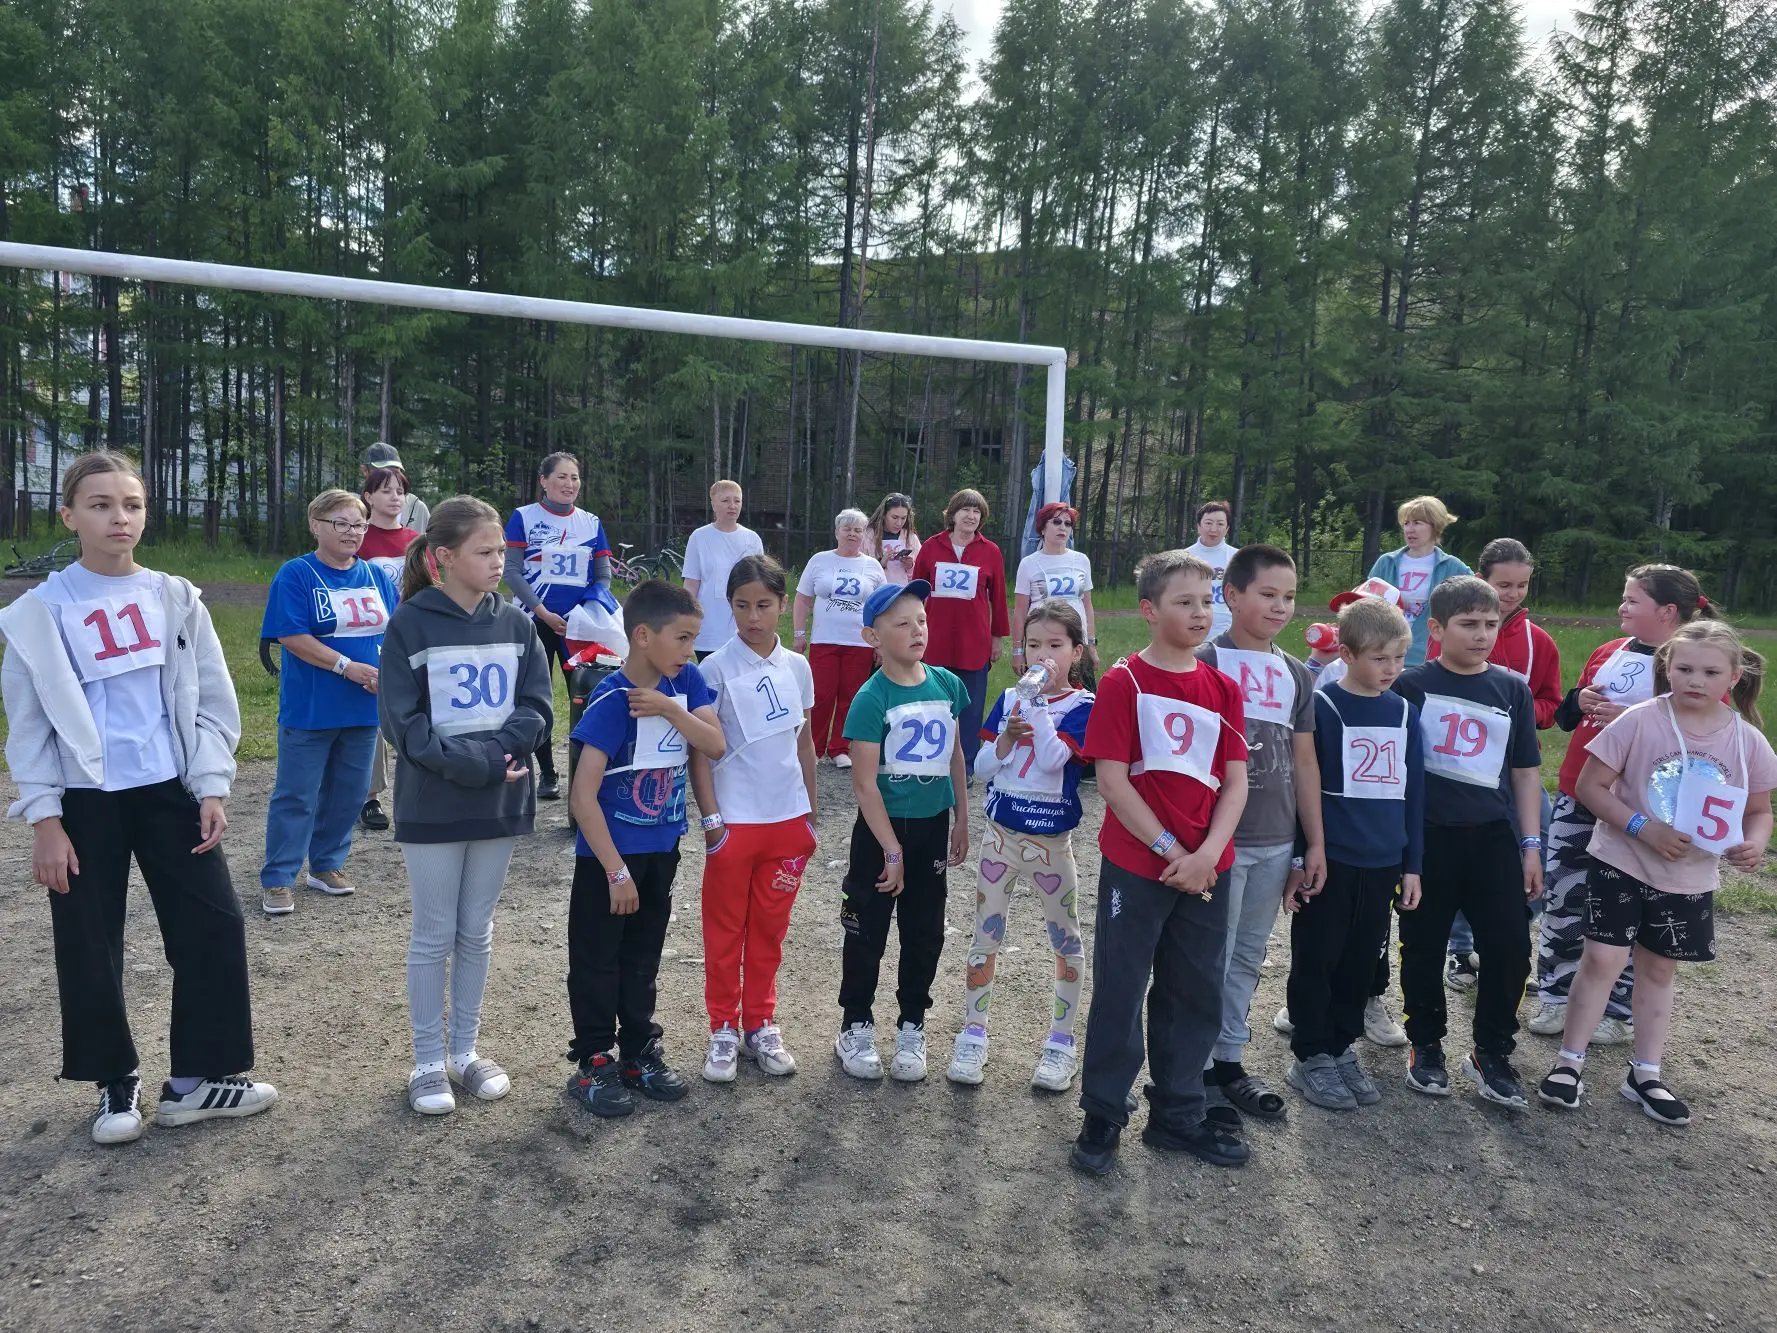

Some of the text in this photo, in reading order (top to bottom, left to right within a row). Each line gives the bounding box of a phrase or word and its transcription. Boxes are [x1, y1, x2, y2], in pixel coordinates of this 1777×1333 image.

[550, 553, 578, 577] 31
[942, 569, 970, 590] 32
[1399, 571, 1429, 592] 17
[834, 577, 861, 596] 23
[1049, 576, 1076, 596] 22
[343, 597, 384, 627] 15
[84, 602, 161, 660] 11
[449, 663, 508, 709] 30
[1610, 661, 1646, 694] 3
[756, 676, 789, 721] 1
[895, 719, 947, 762] 29
[1164, 712, 1194, 756] 9
[1433, 712, 1488, 757] 19
[1017, 738, 1036, 778] 7
[1351, 738, 1400, 784] 21
[1652, 754, 1670, 766] GIRLS
[1708, 753, 1720, 764] THE
[1718, 761, 1732, 778] WORLD
[1025, 818, 1055, 829] пути
[1697, 795, 1735, 841] 5
